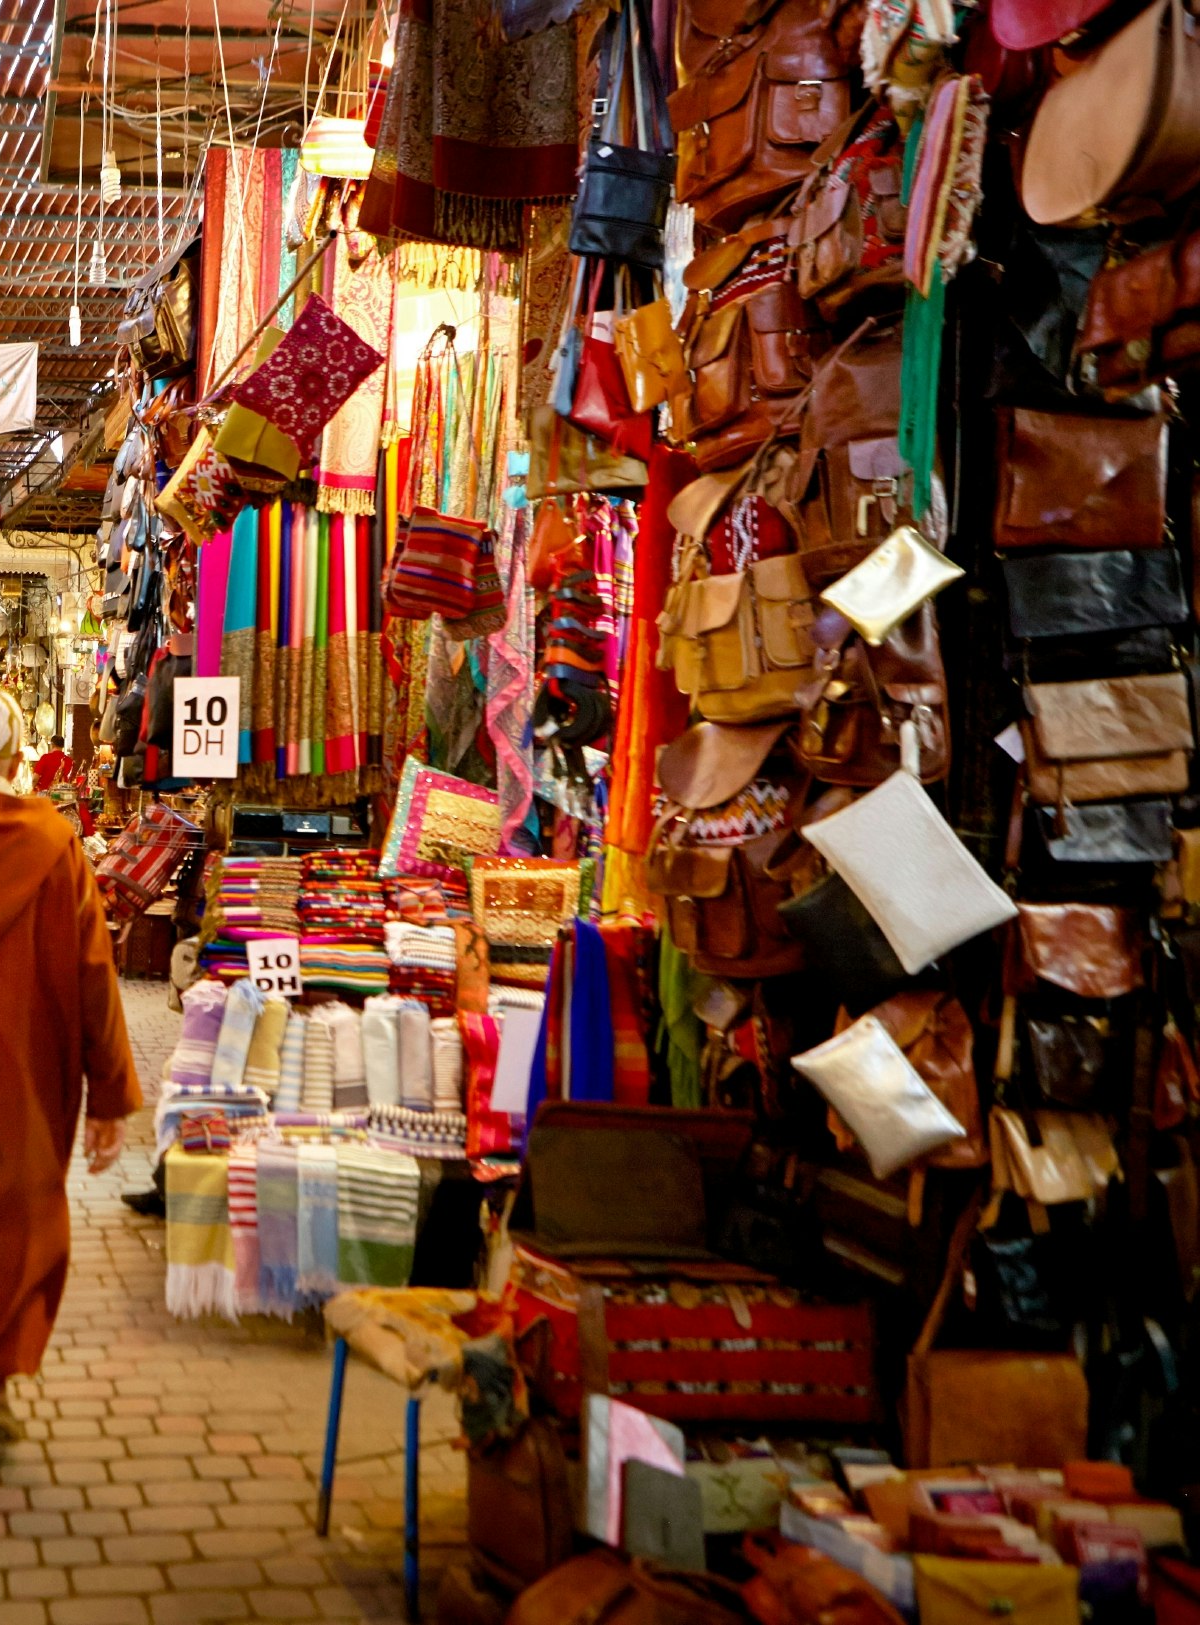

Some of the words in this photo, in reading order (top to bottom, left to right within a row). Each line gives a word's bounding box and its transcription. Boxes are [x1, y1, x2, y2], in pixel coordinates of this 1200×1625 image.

[183, 696, 228, 726] 10
[182, 729, 224, 756] DH
[259, 953, 292, 970] 10
[256, 976, 298, 993] DH
